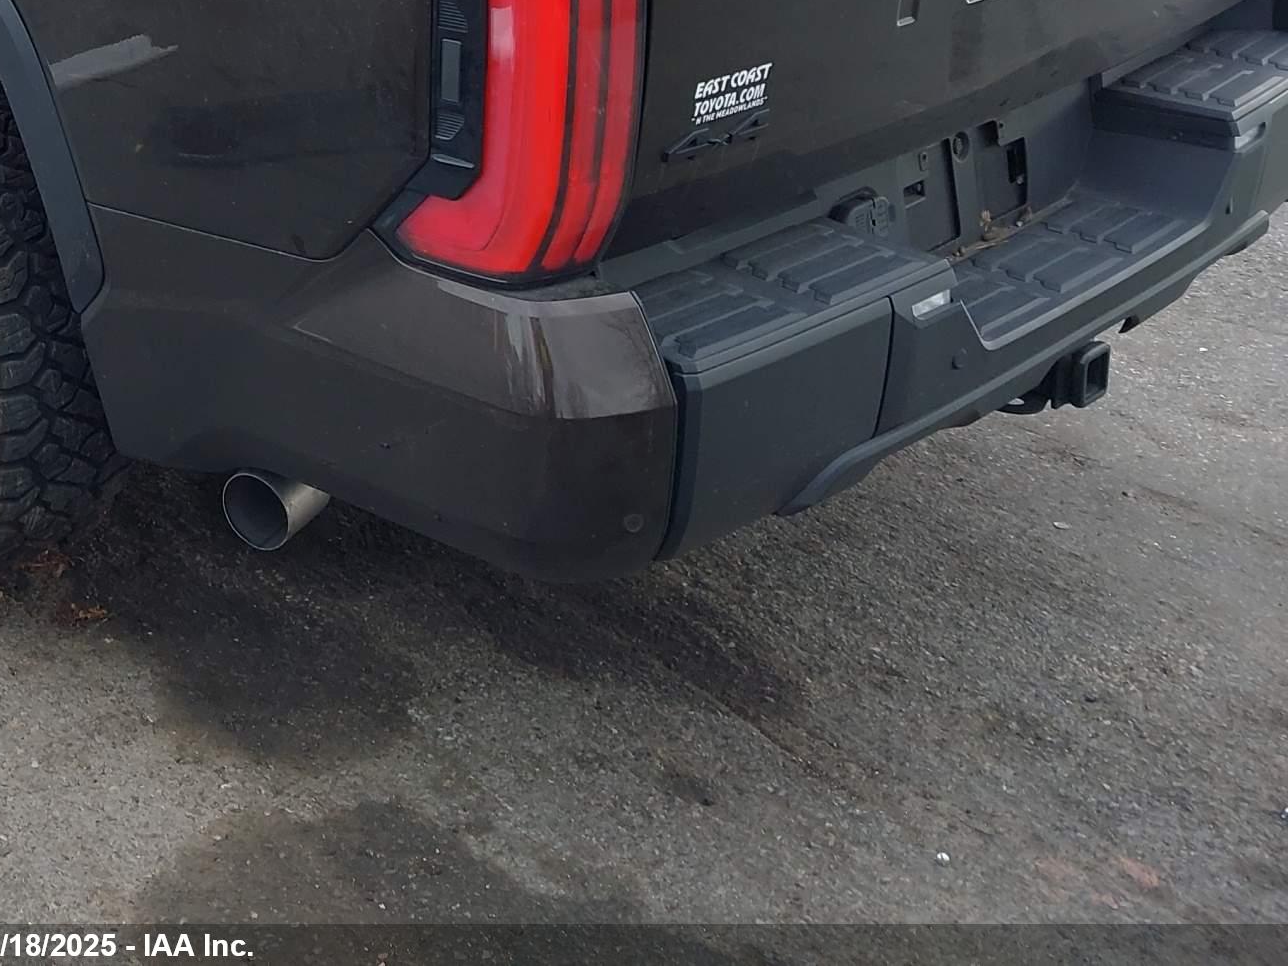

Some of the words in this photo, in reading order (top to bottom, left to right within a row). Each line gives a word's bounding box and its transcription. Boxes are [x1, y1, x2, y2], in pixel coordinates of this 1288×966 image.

[694, 75, 731, 100] EAST
[730, 62, 773, 88] COAST
[694, 83, 766, 118] TOYOTA.COM
